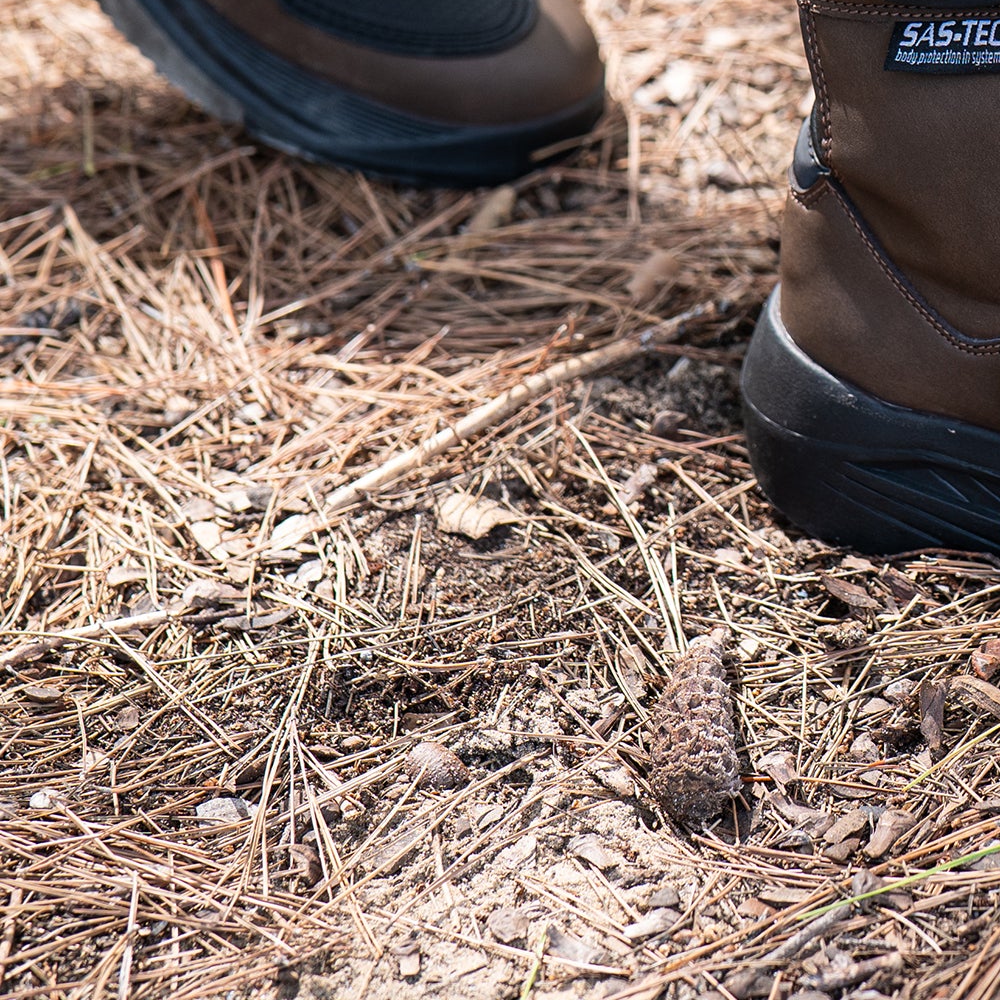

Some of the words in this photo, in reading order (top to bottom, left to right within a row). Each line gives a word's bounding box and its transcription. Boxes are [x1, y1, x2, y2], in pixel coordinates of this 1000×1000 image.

[895, 48, 917, 65] body
[917, 50, 961, 65] protection
[962, 49, 970, 64] in
